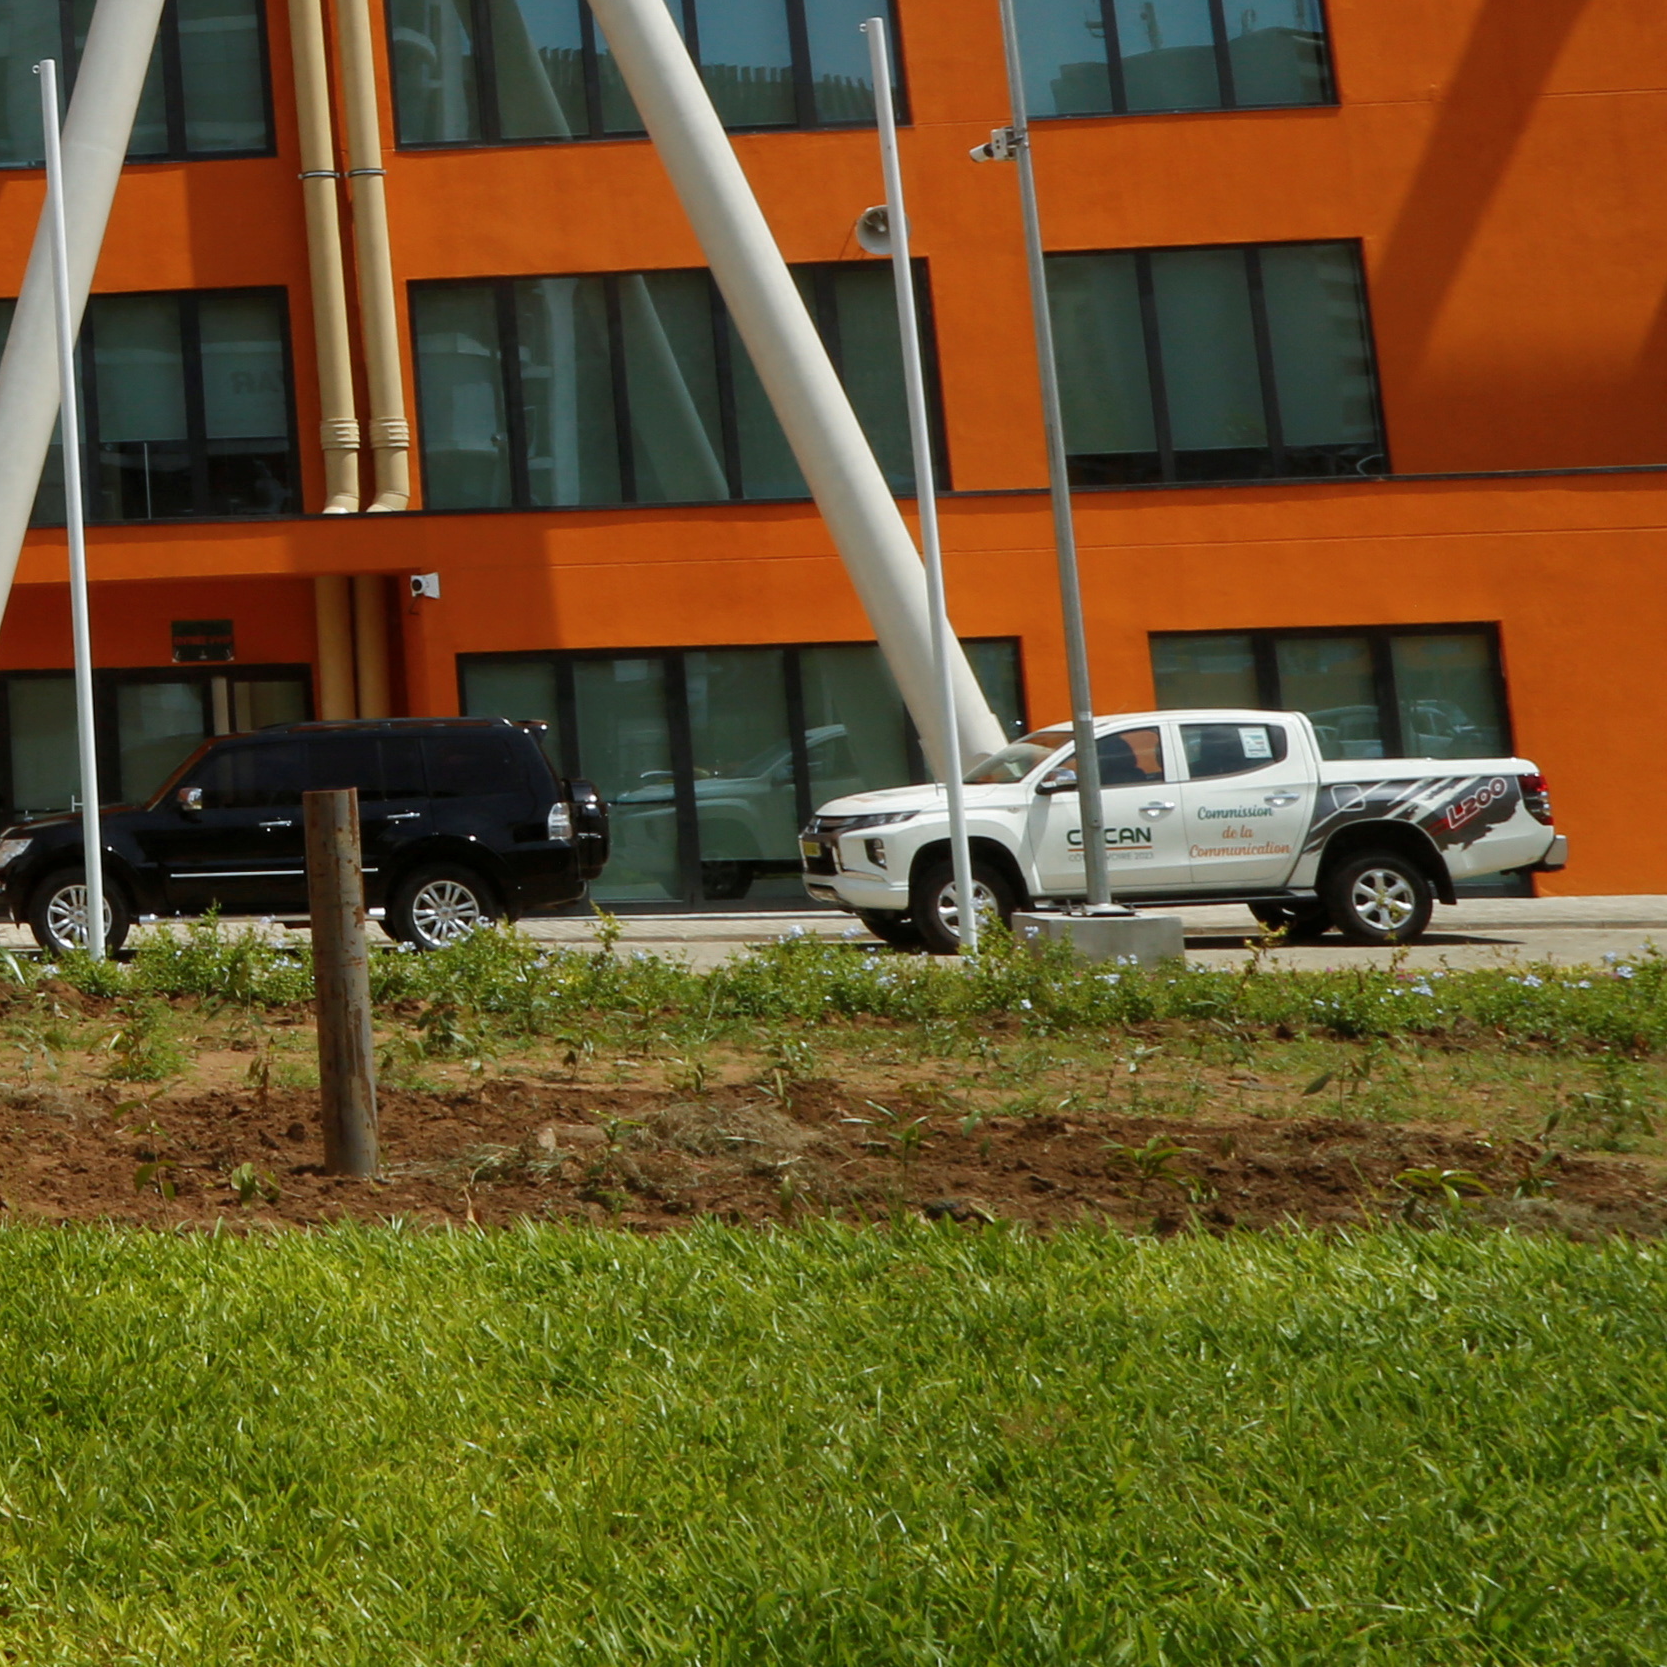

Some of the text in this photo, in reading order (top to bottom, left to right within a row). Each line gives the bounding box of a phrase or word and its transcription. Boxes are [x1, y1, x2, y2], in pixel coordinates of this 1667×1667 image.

[1446, 777, 1507, 829] L200
[1197, 805, 1274, 820] Commission
[1066, 827, 1151, 845] CCAN
[1222, 824, 1254, 839] de la
[1189, 841, 1292, 858] Communication
